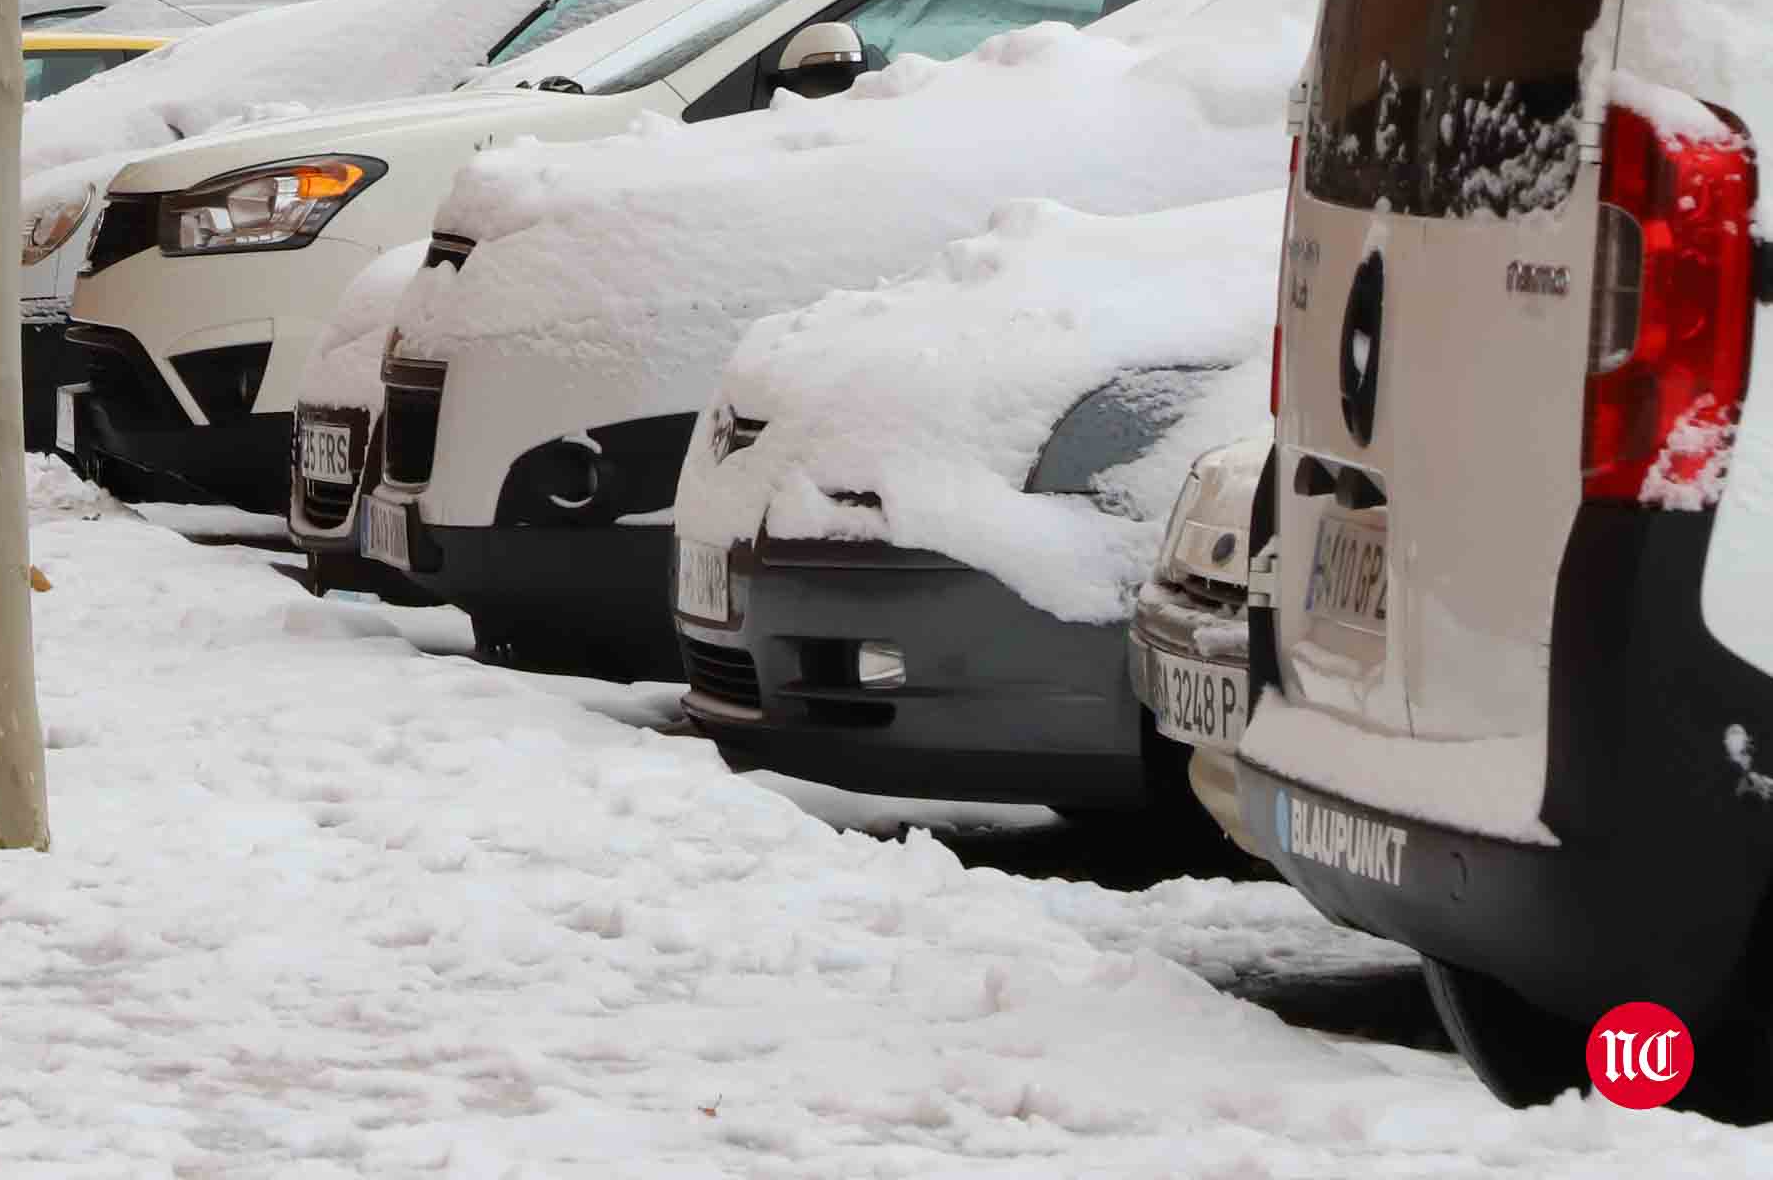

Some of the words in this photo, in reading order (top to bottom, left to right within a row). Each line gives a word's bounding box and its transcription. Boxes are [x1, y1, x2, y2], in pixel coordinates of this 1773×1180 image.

[319, 432, 348, 475] FRS
[1173, 668, 1216, 736] 3248
[1291, 798, 1407, 887] BLAUPUNKT
